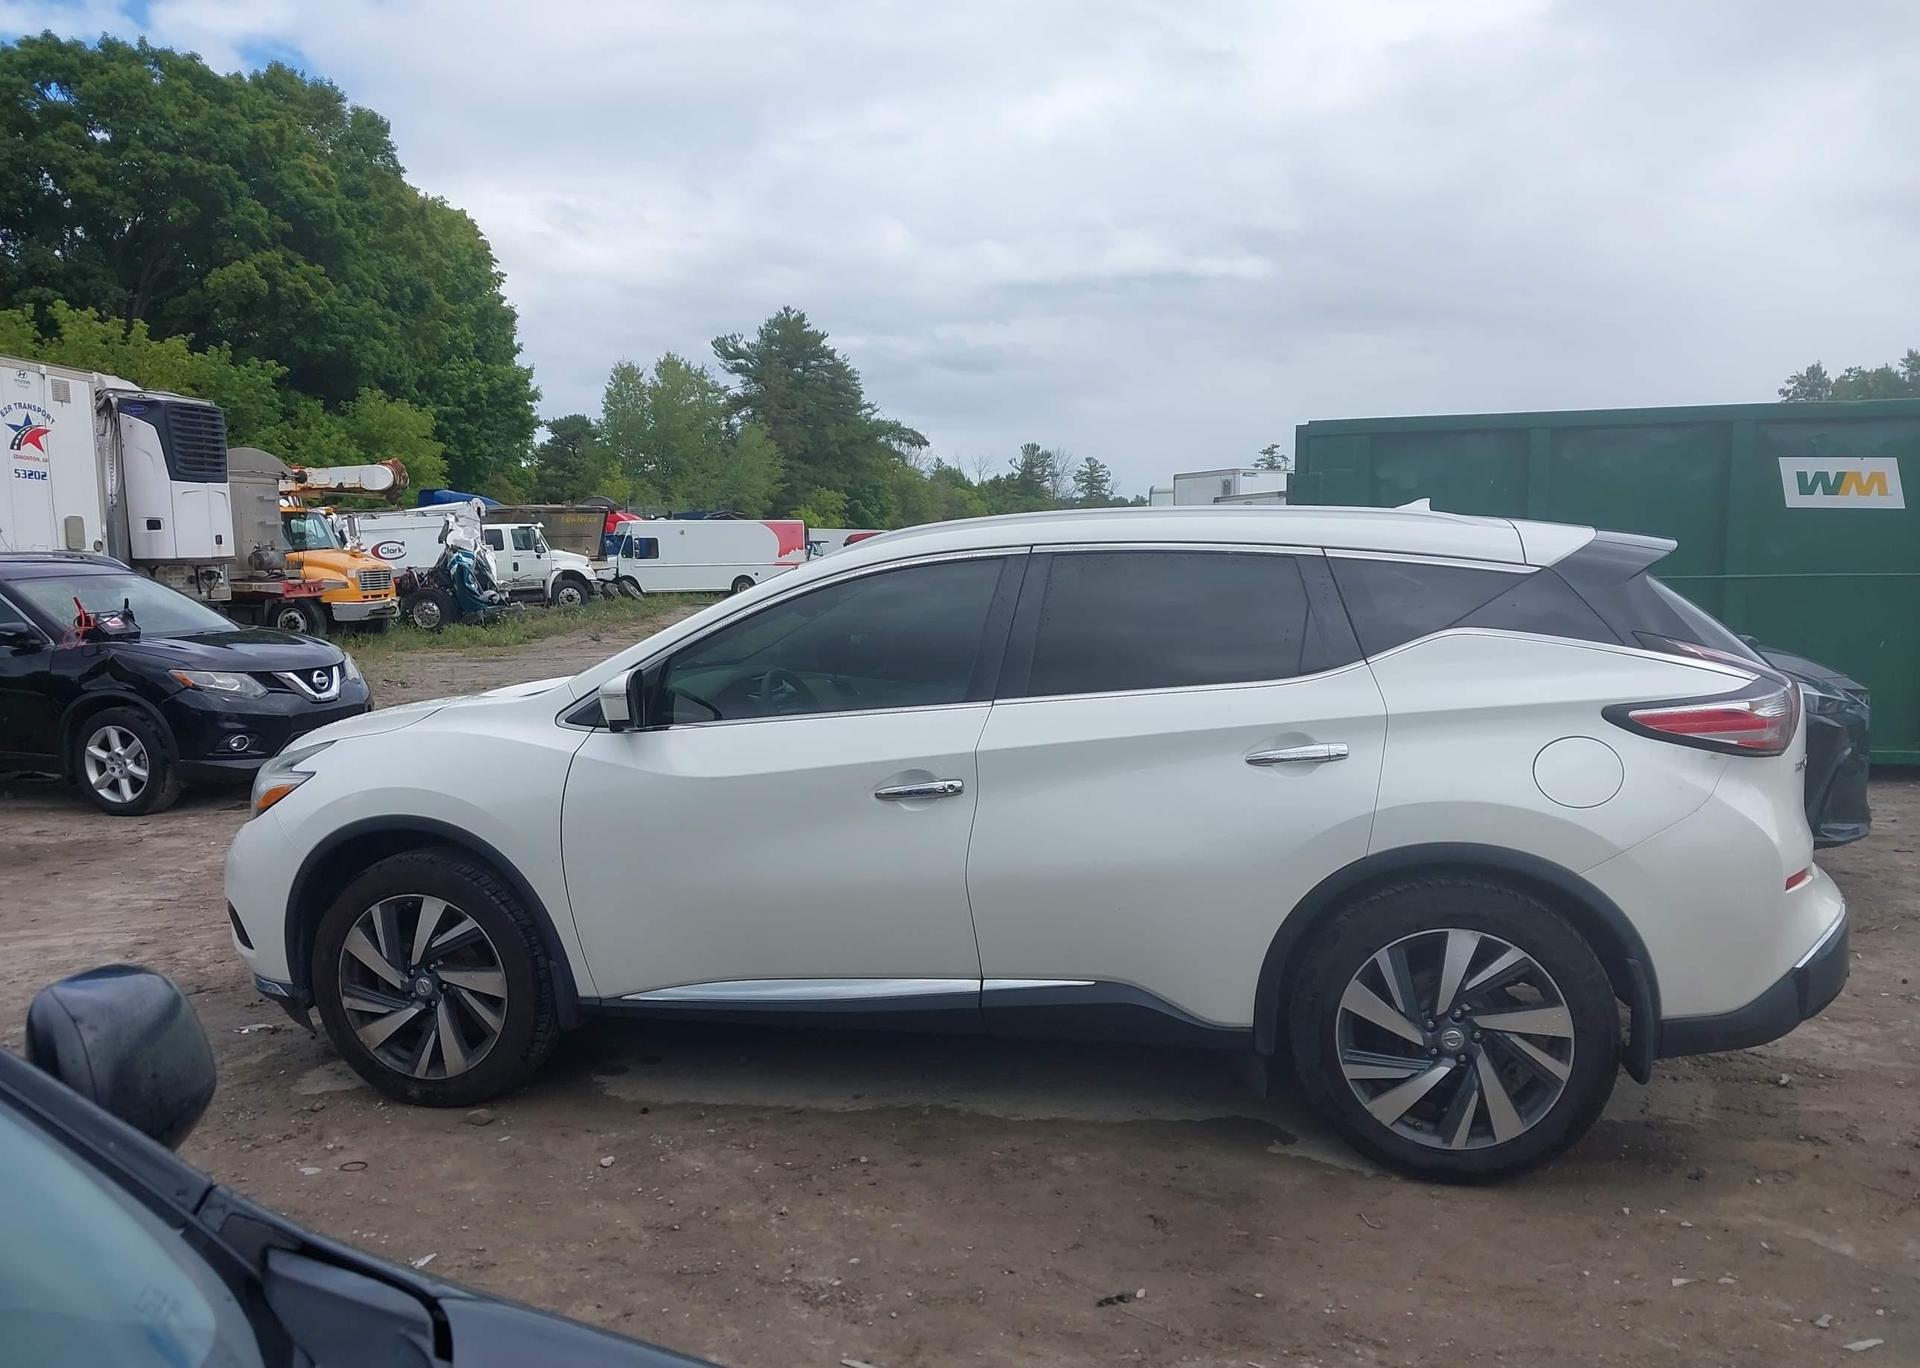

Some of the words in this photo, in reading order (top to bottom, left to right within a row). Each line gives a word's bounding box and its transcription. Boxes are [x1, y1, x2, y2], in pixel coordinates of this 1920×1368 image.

[0, 404, 13, 418] E2R
[13, 402, 56, 424] TRANSPORT
[14, 468, 48, 480] 53202
[1796, 471, 1889, 496] WM
[380, 546, 404, 555] Clark
